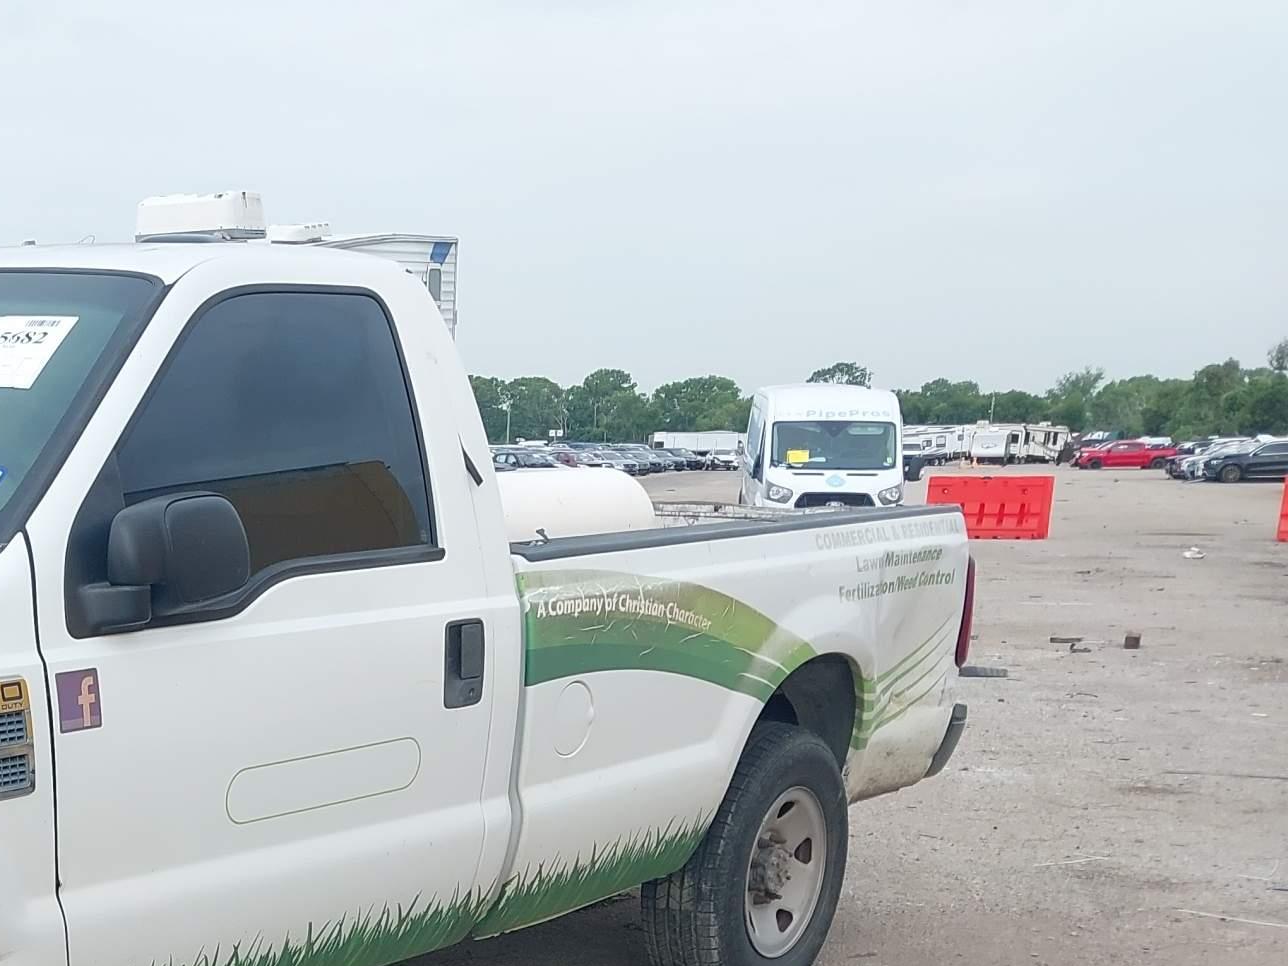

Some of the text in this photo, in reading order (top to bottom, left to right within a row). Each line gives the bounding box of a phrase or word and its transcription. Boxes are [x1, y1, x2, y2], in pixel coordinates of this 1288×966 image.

[805, 409, 891, 419] PipePros
[814, 527, 891, 551] COMMERCIAL
[902, 518, 960, 540] RESIDENTIAL
[855, 547, 943, 573] Lawn Maintenance
[918, 567, 956, 585] Control
[536, 592, 712, 631] A Company of Christian Character
[1, 702, 24, 711] DUTY
